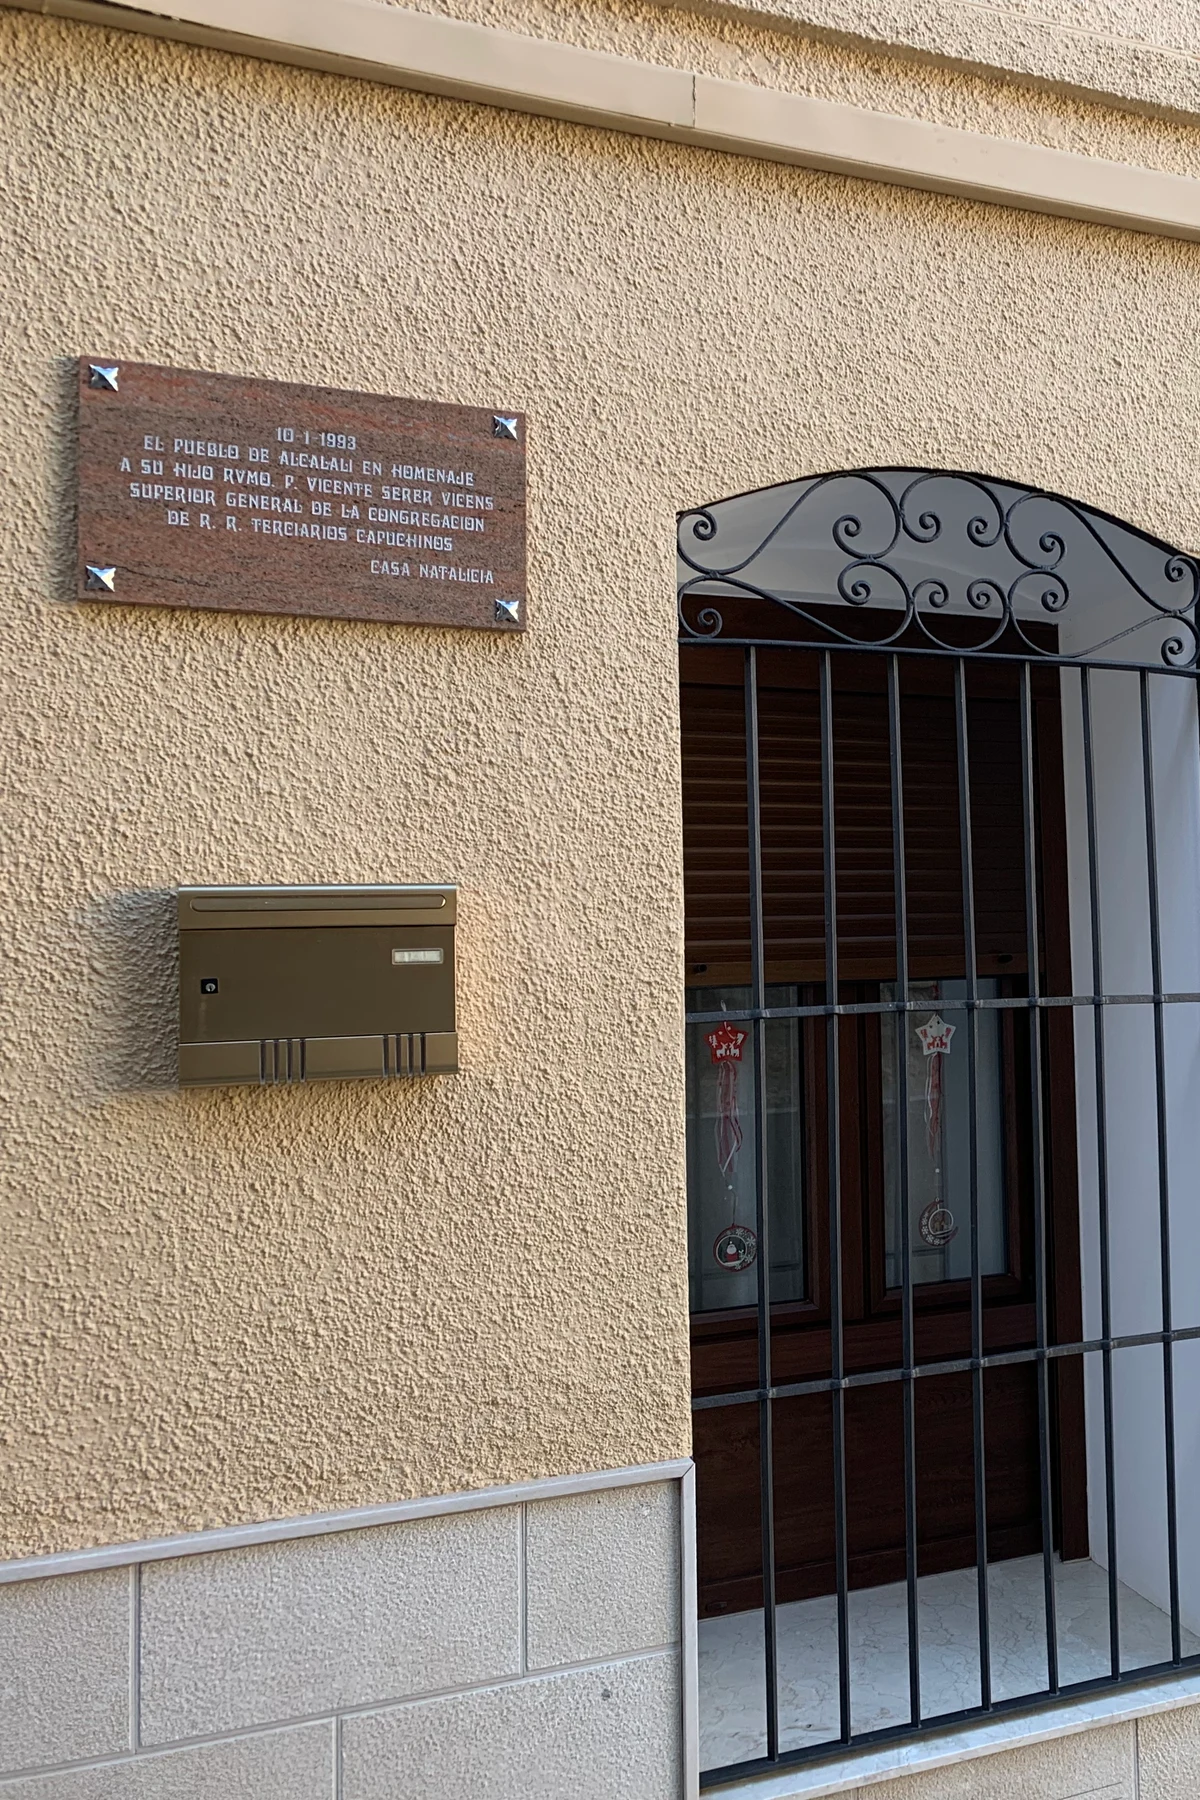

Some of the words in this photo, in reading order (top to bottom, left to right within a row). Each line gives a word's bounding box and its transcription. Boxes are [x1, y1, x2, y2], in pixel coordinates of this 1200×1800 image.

[120, 457, 131, 473] A
[141, 459, 163, 475] SU
[173, 462, 214, 481] HIJO
[306, 476, 373, 498] VICENTE
[381, 485, 433, 506] SERER
[442, 491, 494, 511] VICENS
[143, 435, 164, 451] EL
[174, 438, 239, 460] PUEBLO
[249, 447, 270, 463] DE
[279, 450, 353, 473] ALCALALI
[362, 460, 382, 476] EN
[391, 463, 475, 487] HOMENAJE
[129, 482, 216, 506] SUPERIOR
[226, 492, 302, 514] GENERAL
[311, 500, 332, 516] DE
[341, 503, 360, 520] LA
[368, 506, 485, 532] CONGREGACION
[167, 510, 189, 526] DE
[200, 513, 216, 530] R.
[226, 516, 242, 532] R.
[251, 517, 348, 541] TERCIARIOS
[356, 528, 453, 551] CAPUCHINOS
[370, 559, 411, 577] CASA
[419, 563, 495, 584] NATALICIA
